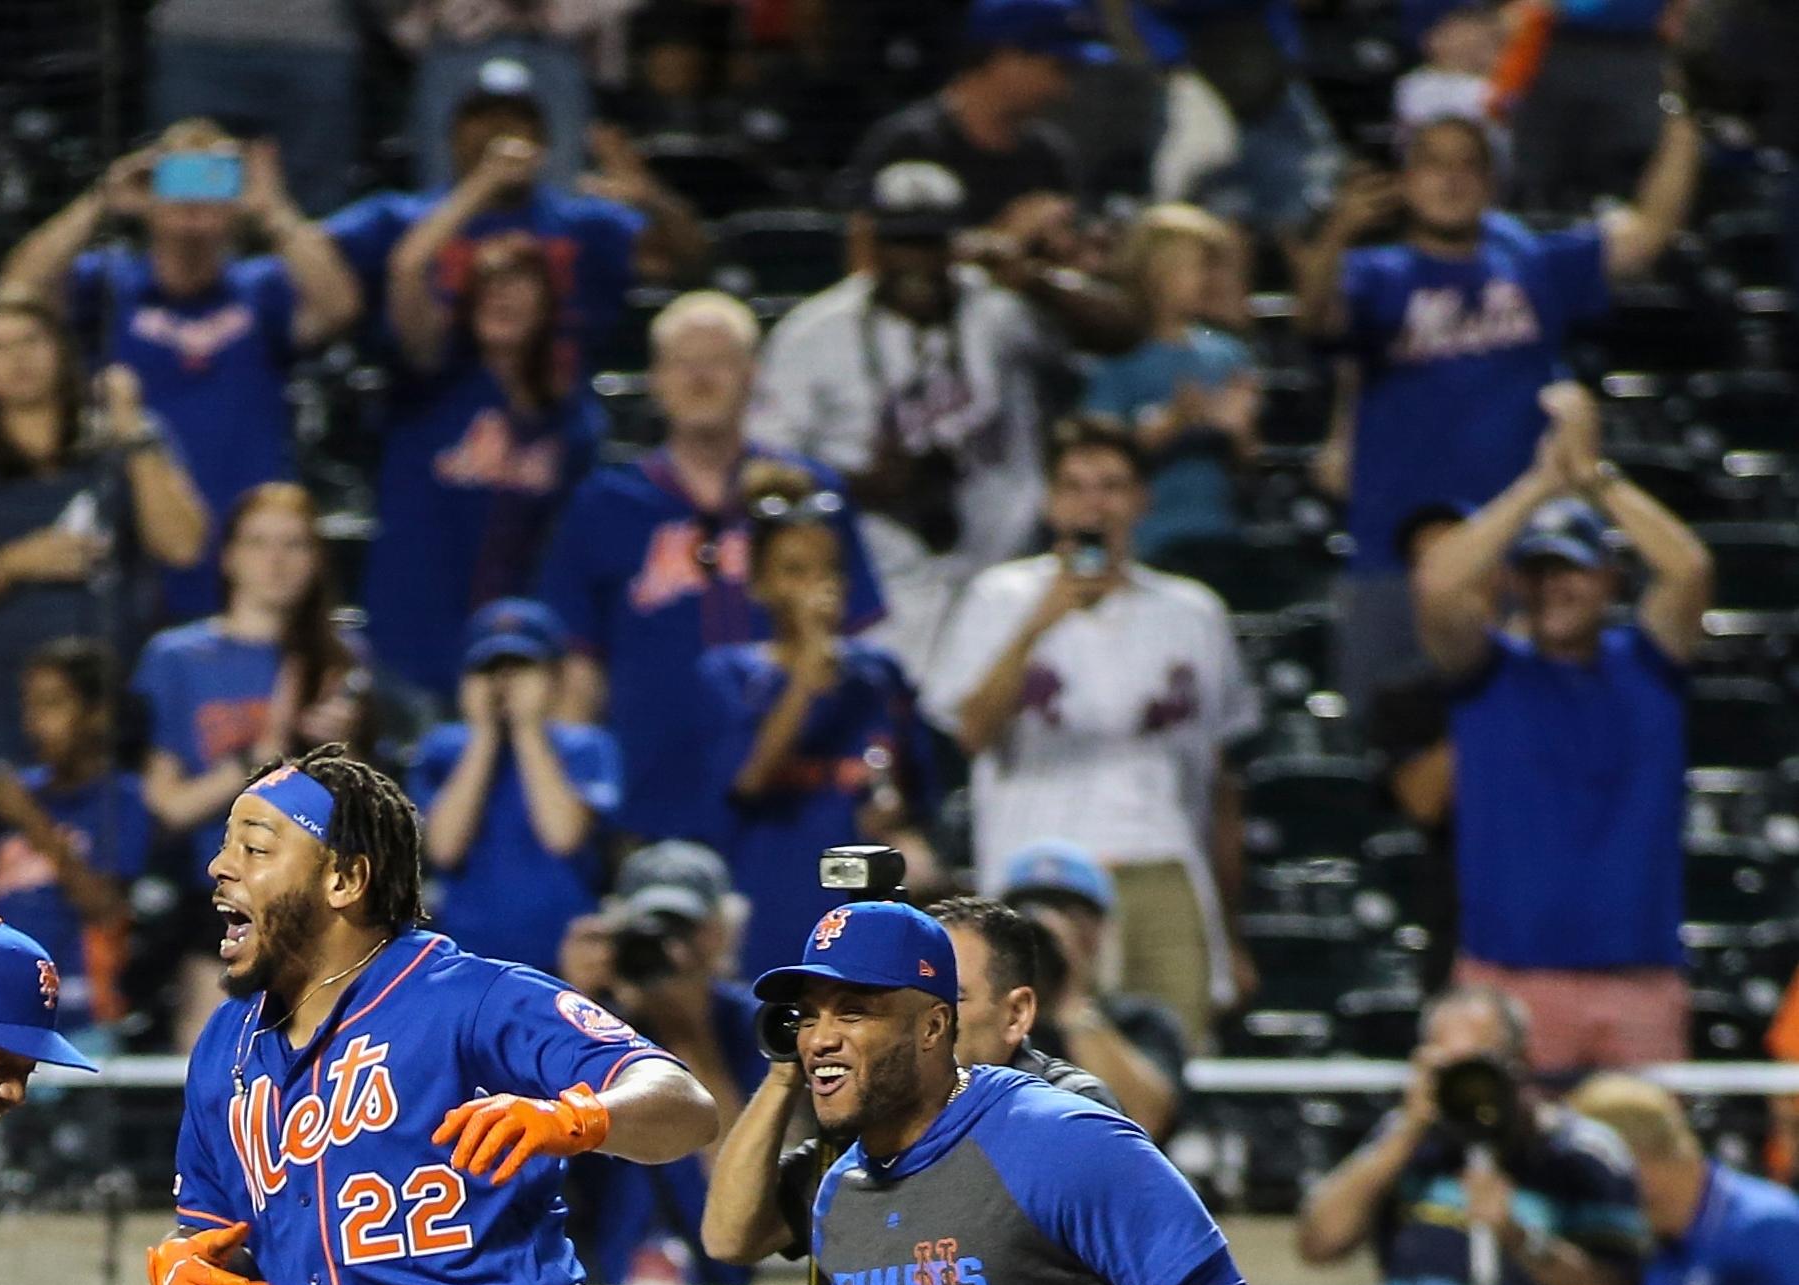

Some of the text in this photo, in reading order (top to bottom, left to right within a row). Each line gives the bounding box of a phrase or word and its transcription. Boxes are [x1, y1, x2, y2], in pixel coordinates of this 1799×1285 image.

[293, 812, 324, 836] JUNK
[228, 1033, 399, 1218] Mets
[336, 1163, 474, 1266] 22
